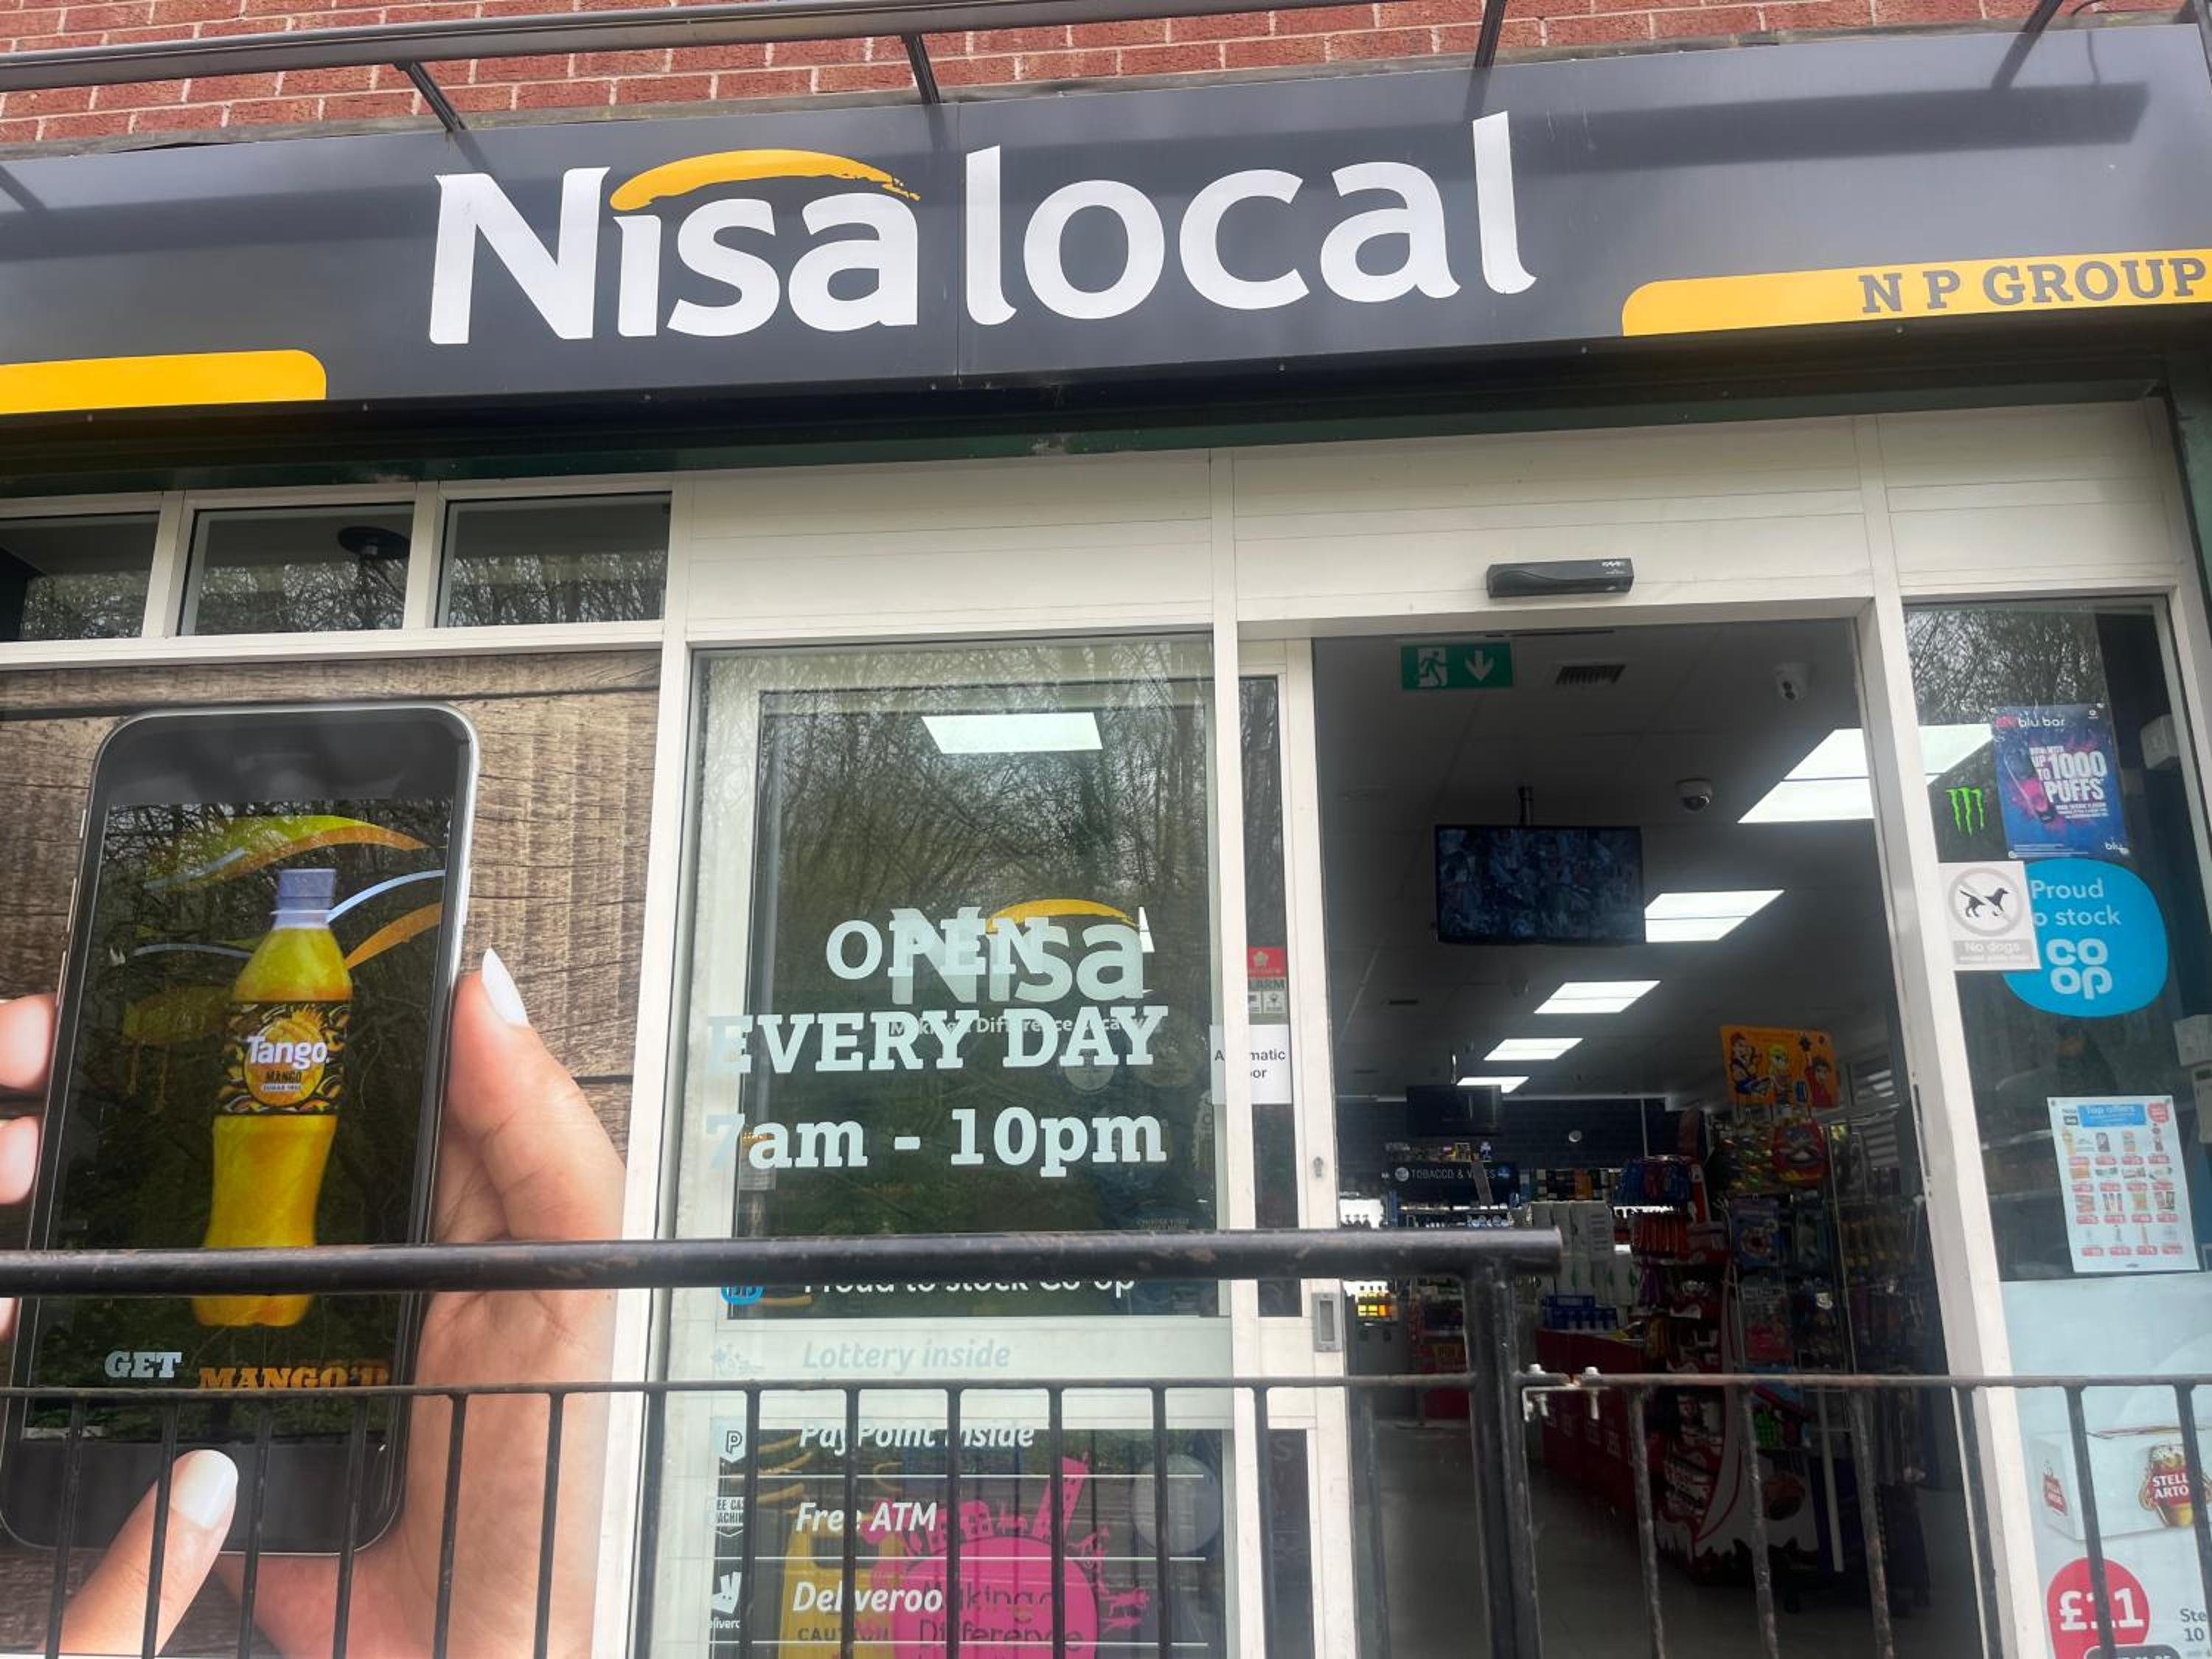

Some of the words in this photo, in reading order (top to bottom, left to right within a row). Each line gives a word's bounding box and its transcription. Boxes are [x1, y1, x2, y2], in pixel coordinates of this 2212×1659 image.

[429, 150, 920, 345] Nisa
[966, 111, 1537, 326] local
[1858, 273, 1902, 313] N
[1922, 270, 1961, 310] P
[1983, 257, 2206, 306] GROUP
[2048, 751, 2107, 779] 1000
[2030, 878, 2105, 899] Proud
[2055, 904, 2121, 927] stock
[826, 917, 1050, 980] OPEN
[890, 901, 1145, 1004] Nisa
[247, 1035, 328, 1070] Tango
[706, 1010, 979, 1074] EVERY
[1002, 1004, 1169, 1068] DAY
[1214, 1048, 1287, 1061] Amatic
[706, 1113, 868, 1169] 7am
[950, 1107, 1167, 1178] 10pm
[1411, 1168, 1455, 1180] TOBACCO
[104, 1351, 182, 1379] GET
[803, 1341, 915, 1373] Lottery
[922, 1340, 1011, 1368] inside
[2153, 1472, 2189, 1487] STELL
[2154, 1484, 2190, 1498] ARTO
[796, 1501, 860, 1532] Fre
[869, 1501, 938, 1531] ATM
[793, 1581, 943, 1613] Delveroo
[2184, 1627, 2205, 1641] 10
